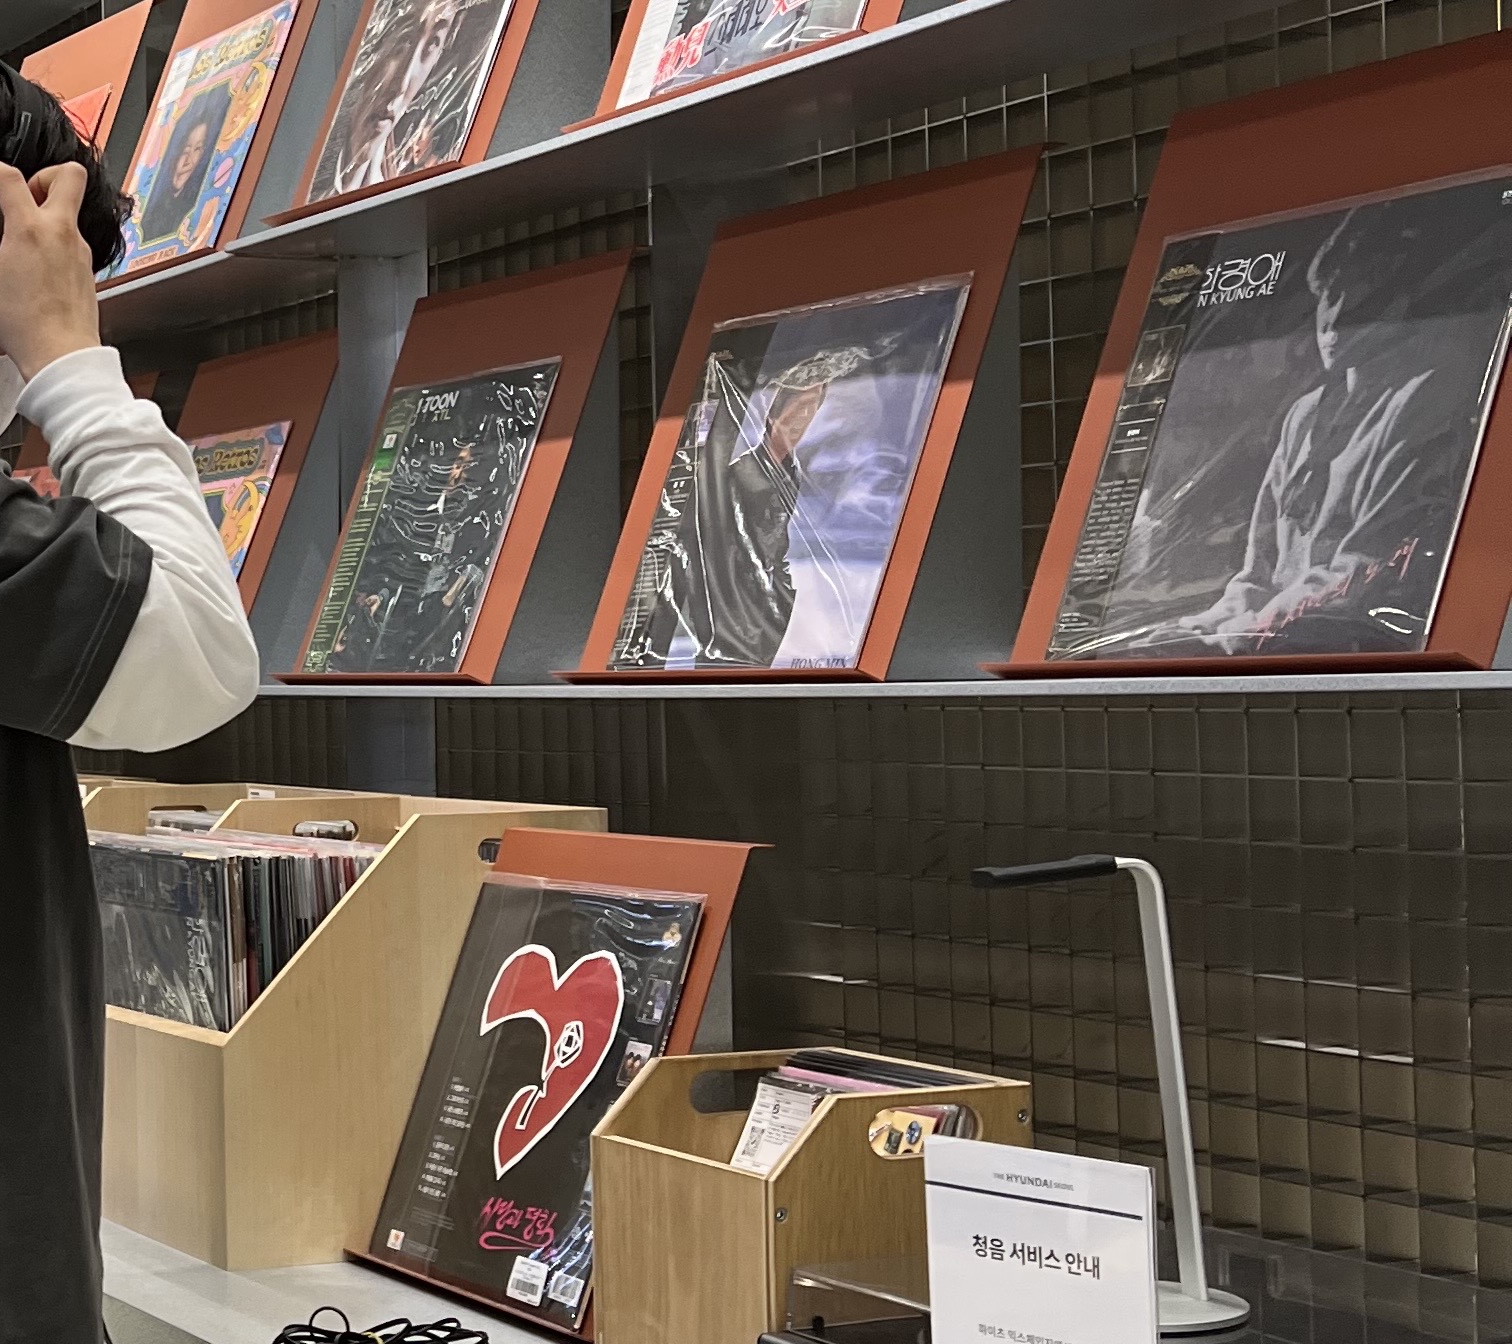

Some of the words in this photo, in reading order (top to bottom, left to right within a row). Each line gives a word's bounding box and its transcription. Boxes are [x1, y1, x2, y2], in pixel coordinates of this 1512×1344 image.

[1209, 284, 1256, 306] KYUNG
[1256, 280, 1277, 297] AE
[1006, 1173, 1053, 1189] HYUNDAI
[972, 1234, 1006, 1262] 청음
[1009, 1242, 1062, 1269] 서비스
[1065, 1252, 1101, 1280] 안내
